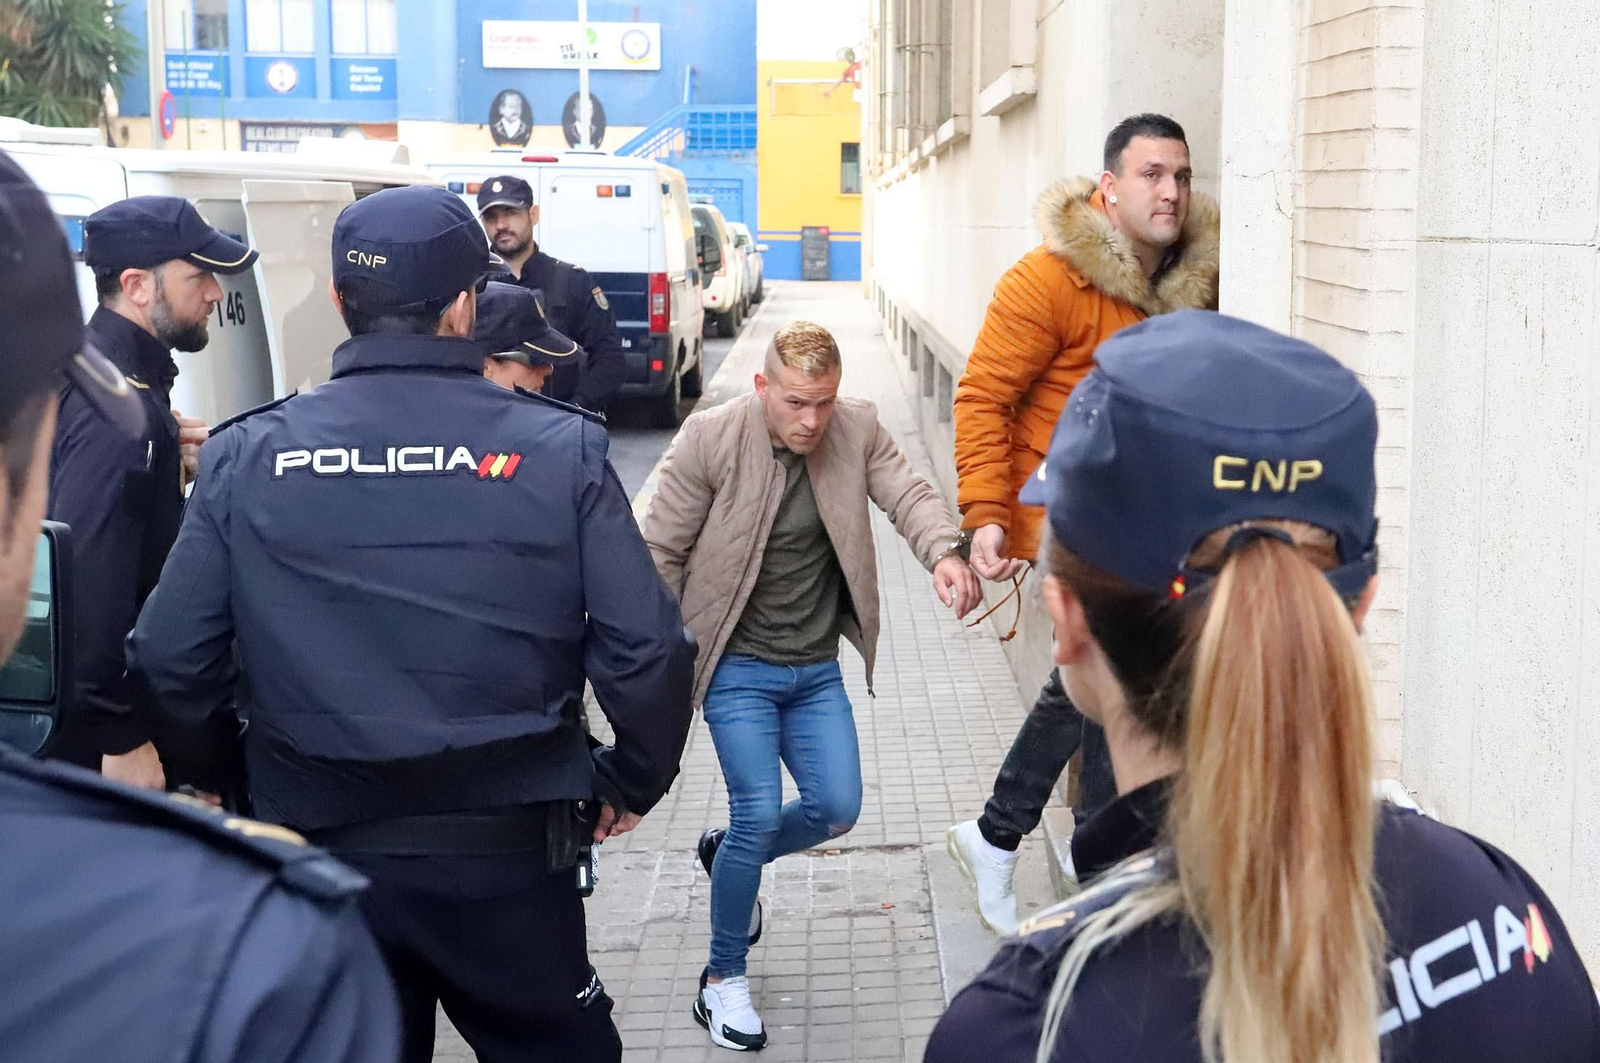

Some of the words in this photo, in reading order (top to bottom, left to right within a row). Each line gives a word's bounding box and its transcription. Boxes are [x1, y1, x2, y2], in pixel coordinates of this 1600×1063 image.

[347, 249, 387, 268] CNP
[275, 446, 479, 476] POLICIA
[1213, 455, 1323, 492] CNP
